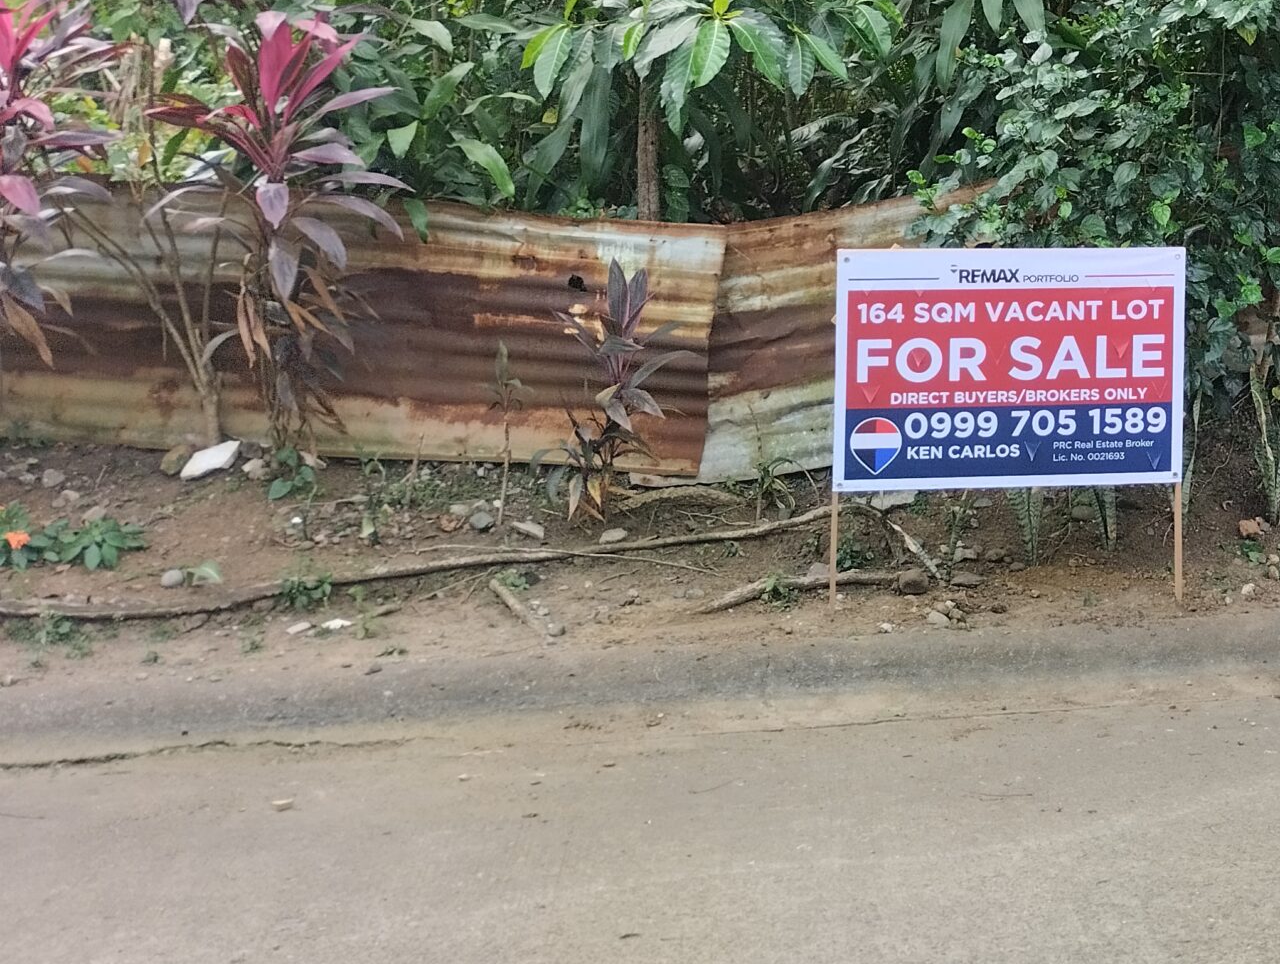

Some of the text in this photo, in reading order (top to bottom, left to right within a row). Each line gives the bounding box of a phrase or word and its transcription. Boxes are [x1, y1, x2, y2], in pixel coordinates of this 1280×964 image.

[1022, 274, 1079, 283] PORTFOLIO
[857, 299, 1165, 324] 164 SQM VACANT LOT
[856, 334, 1165, 383] FOR SALE
[890, 387, 1147, 405] DIRECT BUYERS/BROKERS ONLY
[904, 406, 1167, 439] 0999 705 1589
[906, 443, 1020, 460] KEN CARLOS
[1053, 438, 1154, 450] PRC Real Estate Broker
[1052, 452, 1125, 462] Lic. No. 0021693
